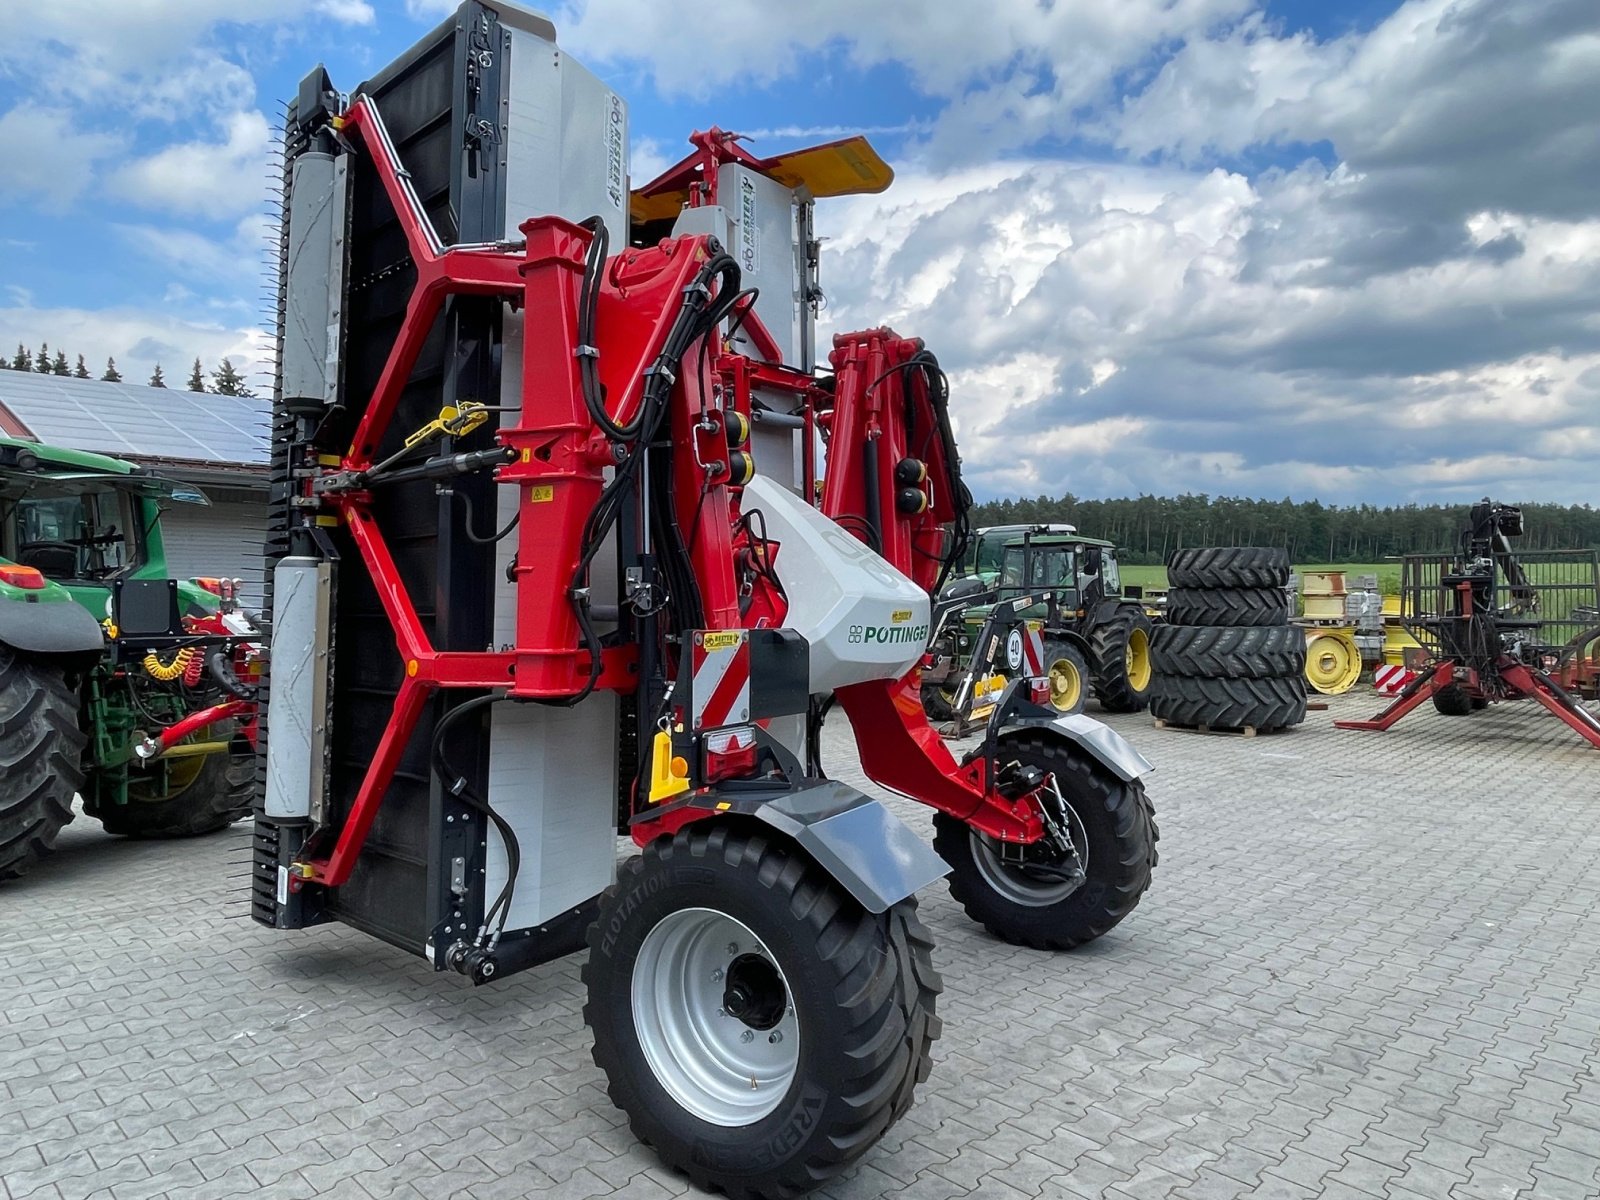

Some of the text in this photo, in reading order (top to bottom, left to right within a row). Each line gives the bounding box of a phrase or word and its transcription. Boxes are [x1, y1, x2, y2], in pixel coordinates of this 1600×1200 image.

[613, 128, 622, 186] RESTER
[743, 195, 751, 245] RESTER
[1010, 639, 1020, 656] 40
[601, 869, 671, 958] FLOTATION
